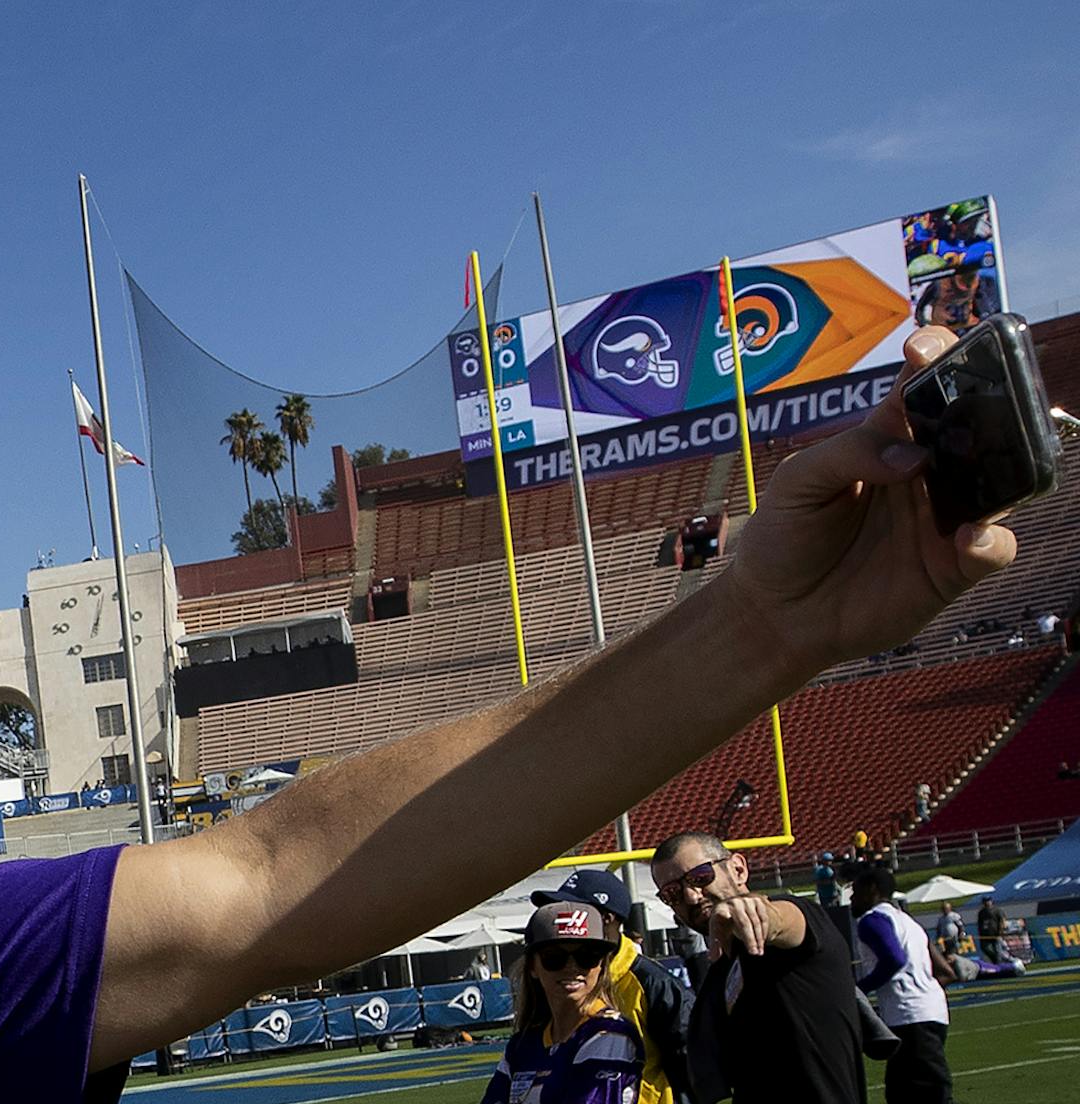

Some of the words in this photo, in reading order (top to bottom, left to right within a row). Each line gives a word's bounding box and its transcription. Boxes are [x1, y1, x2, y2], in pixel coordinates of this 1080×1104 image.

[462, 358, 479, 377] 0
[499, 349, 516, 368] 0
[468, 438, 492, 453] MIN
[507, 429, 527, 443] LA
[515, 376, 895, 486] THERAMS.COM/TICKE
